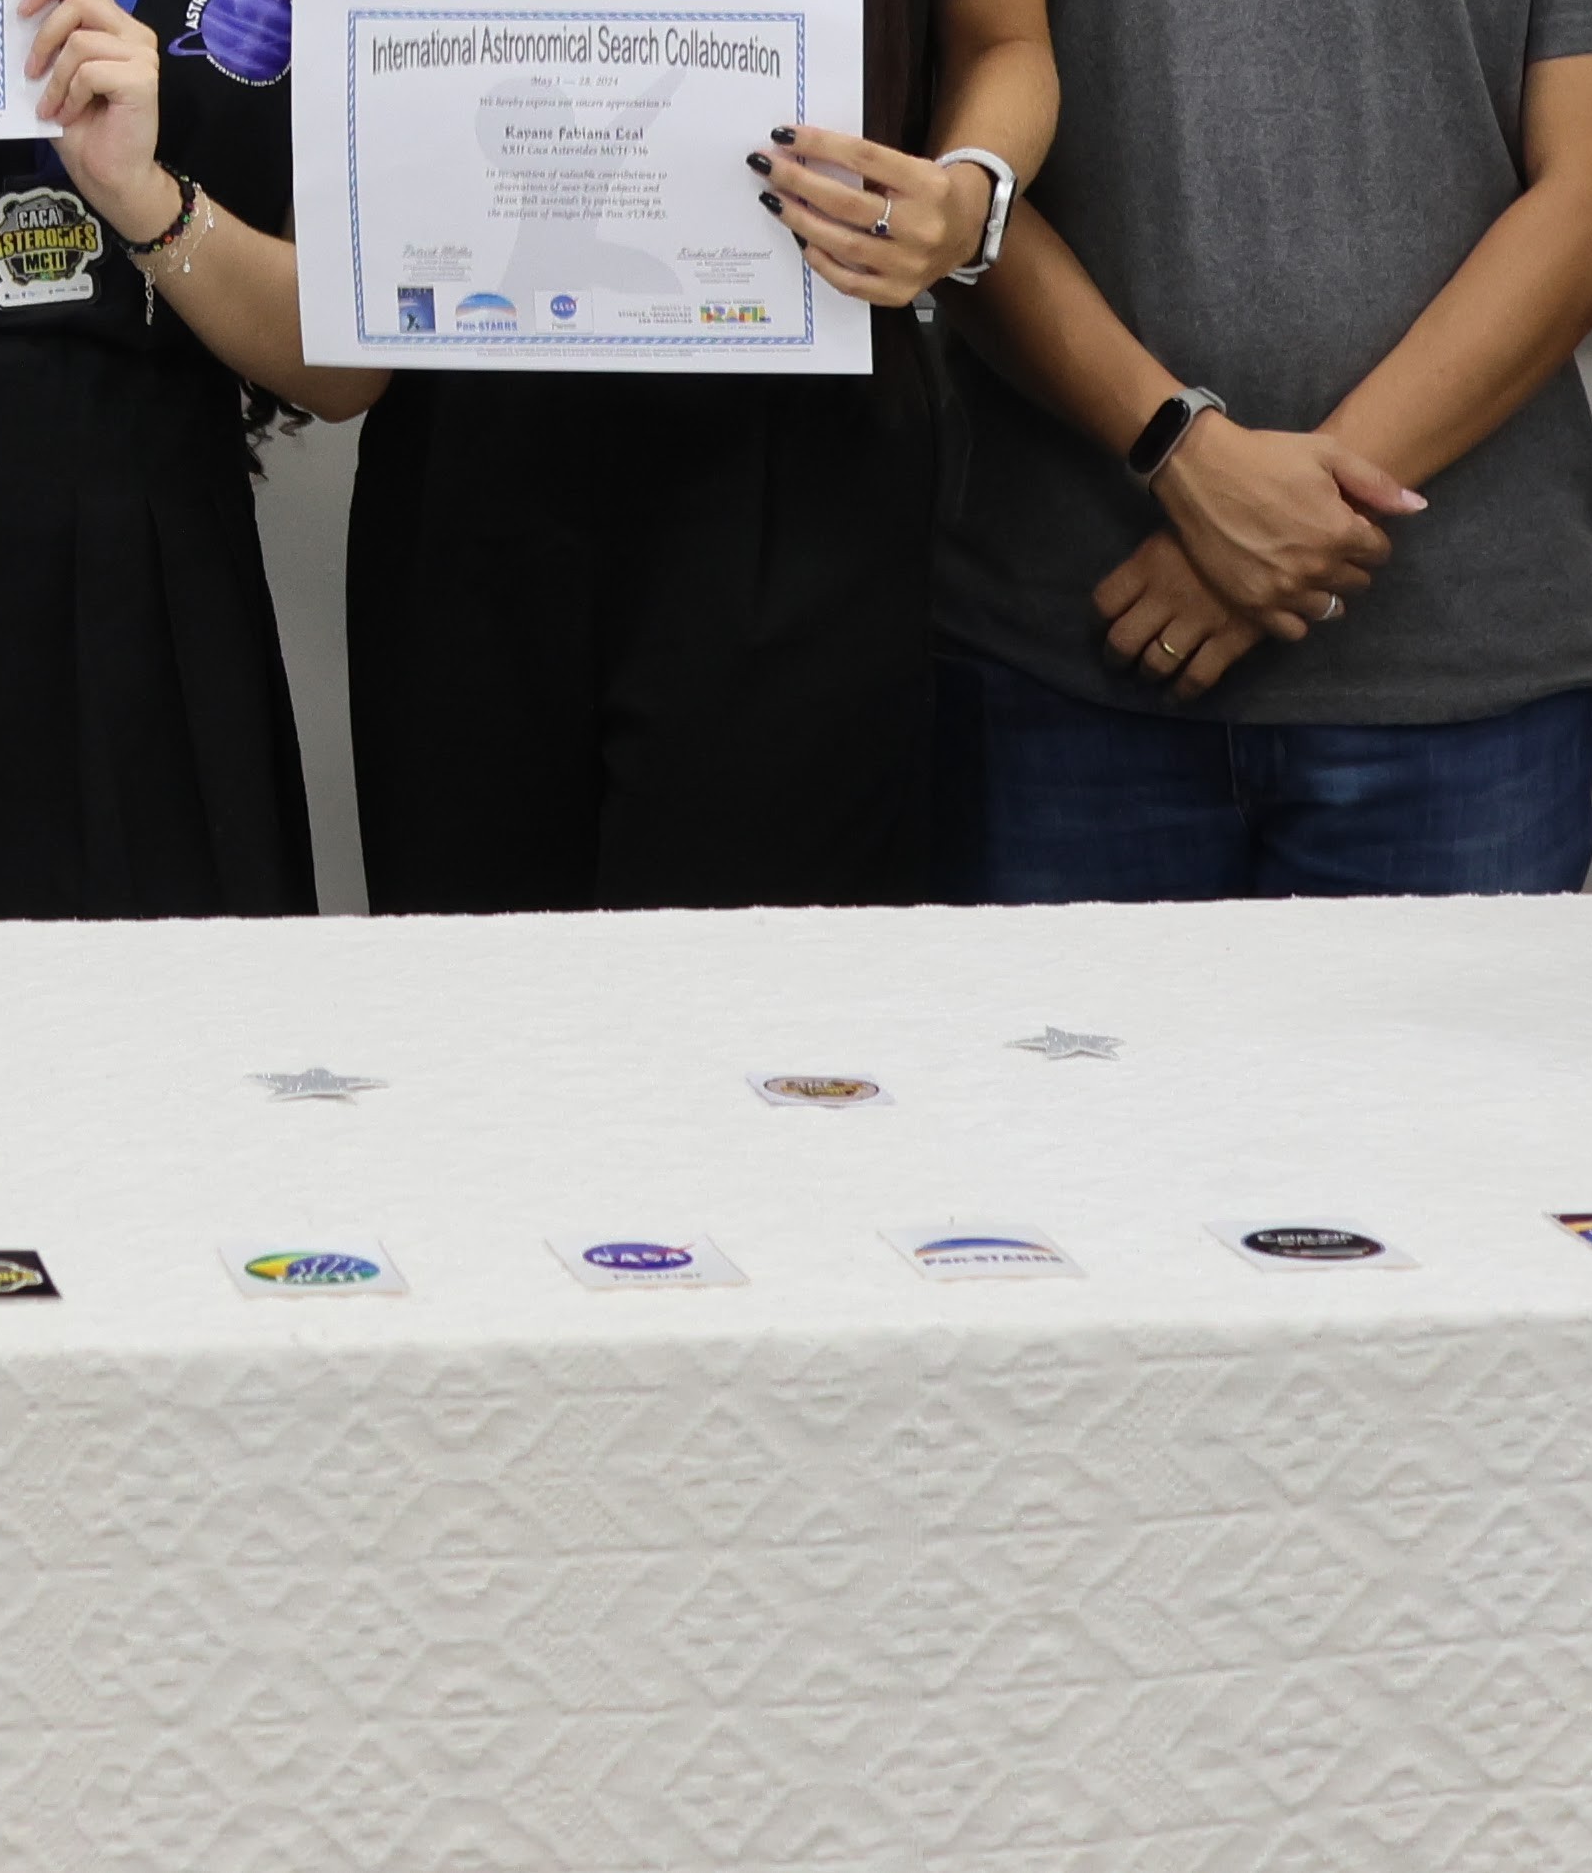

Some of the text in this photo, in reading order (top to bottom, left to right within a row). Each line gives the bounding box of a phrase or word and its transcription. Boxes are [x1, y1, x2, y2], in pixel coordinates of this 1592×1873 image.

[372, 24, 780, 78] International Astronomical Search Collaboration
[559, 126, 611, 141] Fabiana
[19, 206, 59, 229] CAÇA
[25, 251, 64, 272] MCTI
[592, 1251, 686, 1263] NASA
